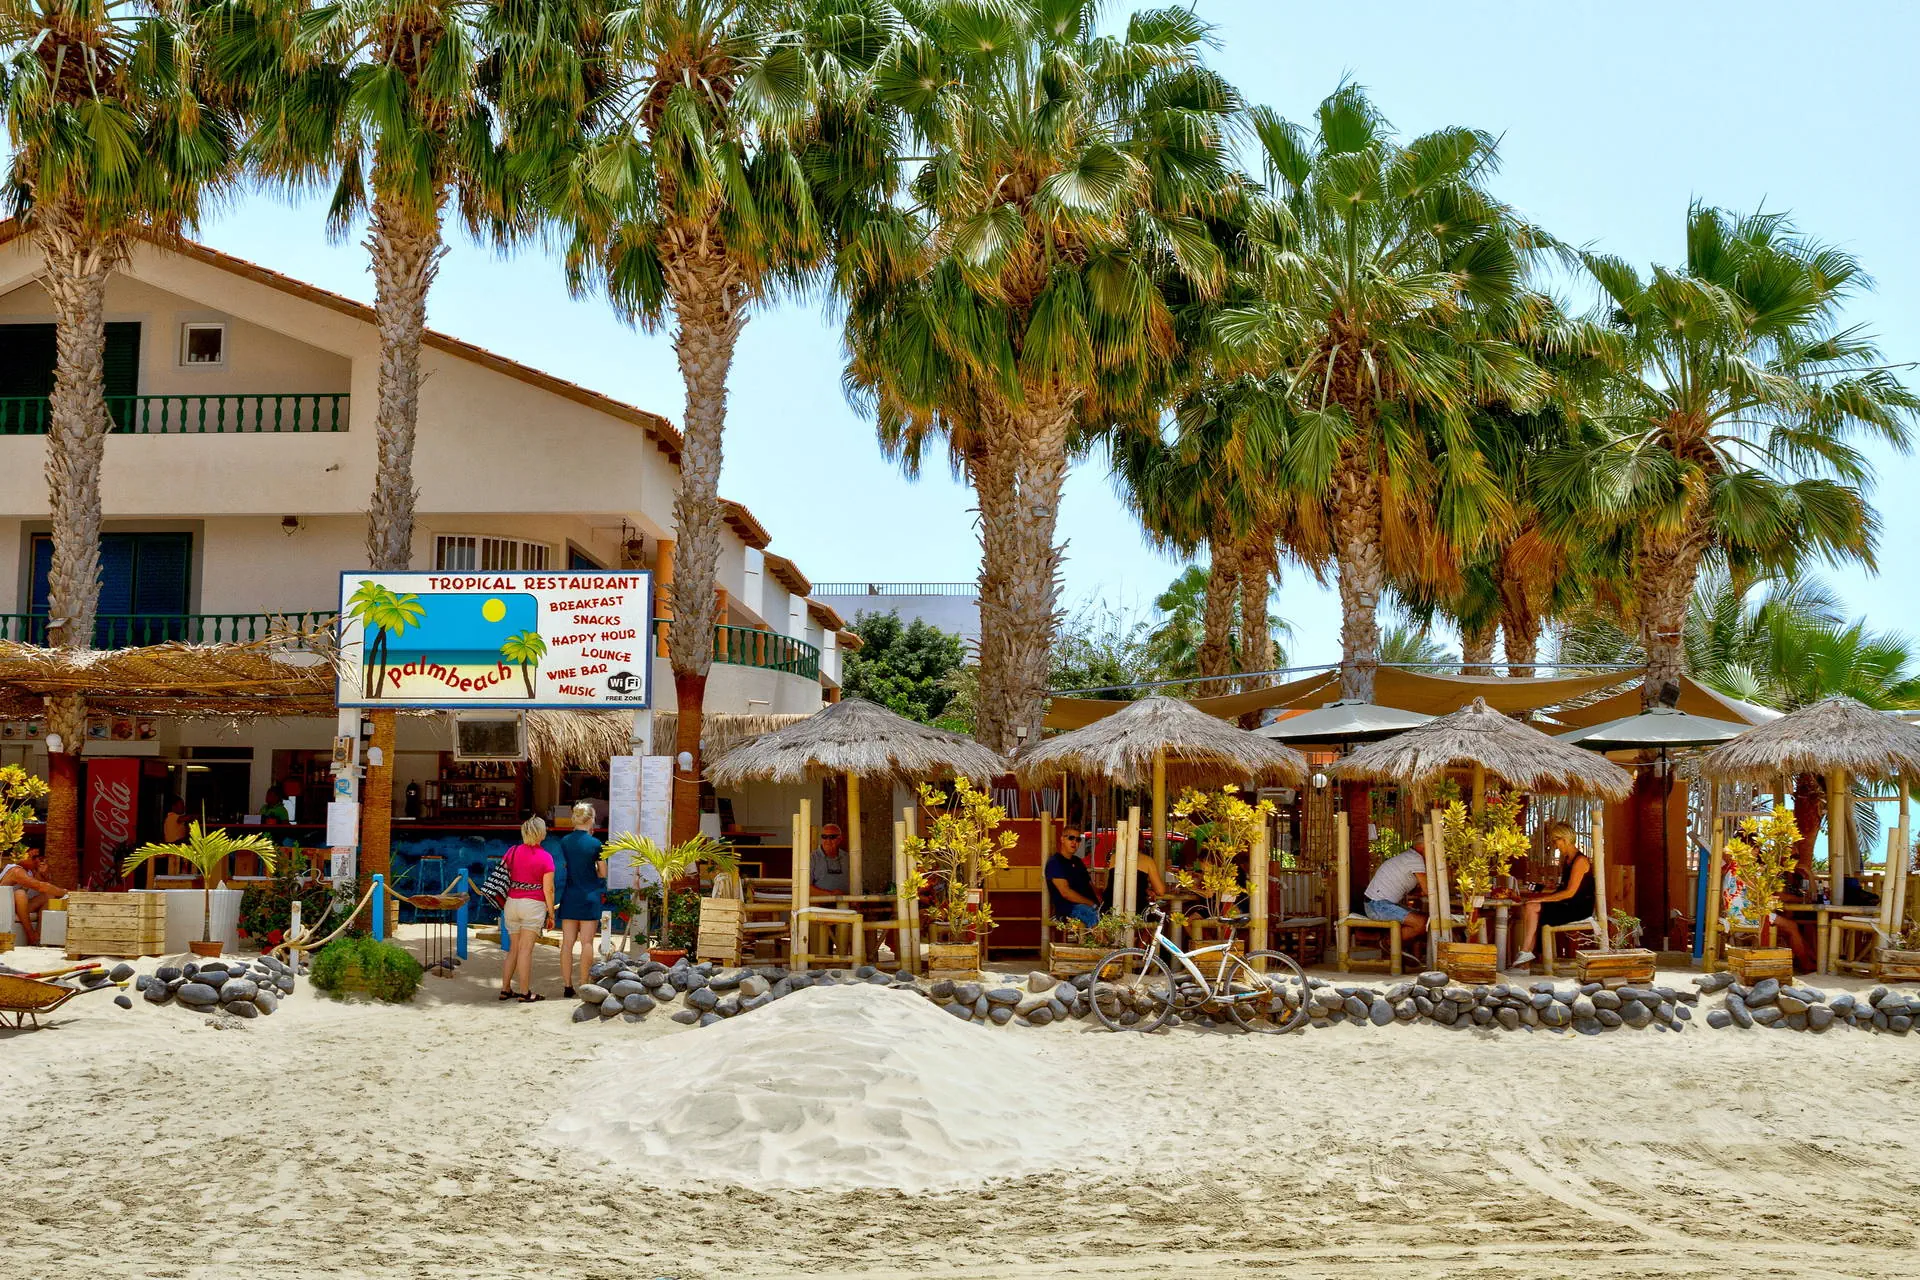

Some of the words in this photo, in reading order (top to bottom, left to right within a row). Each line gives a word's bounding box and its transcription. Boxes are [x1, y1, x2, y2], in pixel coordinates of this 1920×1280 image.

[429, 577, 516, 590] TROPICAL
[524, 577, 640, 590] RESTAURANT
[549, 595, 624, 612] BREAKFAST
[573, 615, 621, 626] SNACKS
[552, 633, 596, 646] HAPPY
[601, 629, 636, 642] HOUR
[581, 647, 631, 662] LOUNGE
[387, 655, 512, 692] palmbeach
[547, 668, 577, 680] WINE
[581, 663, 608, 676] BAR
[559, 684, 597, 697] MUSIC
